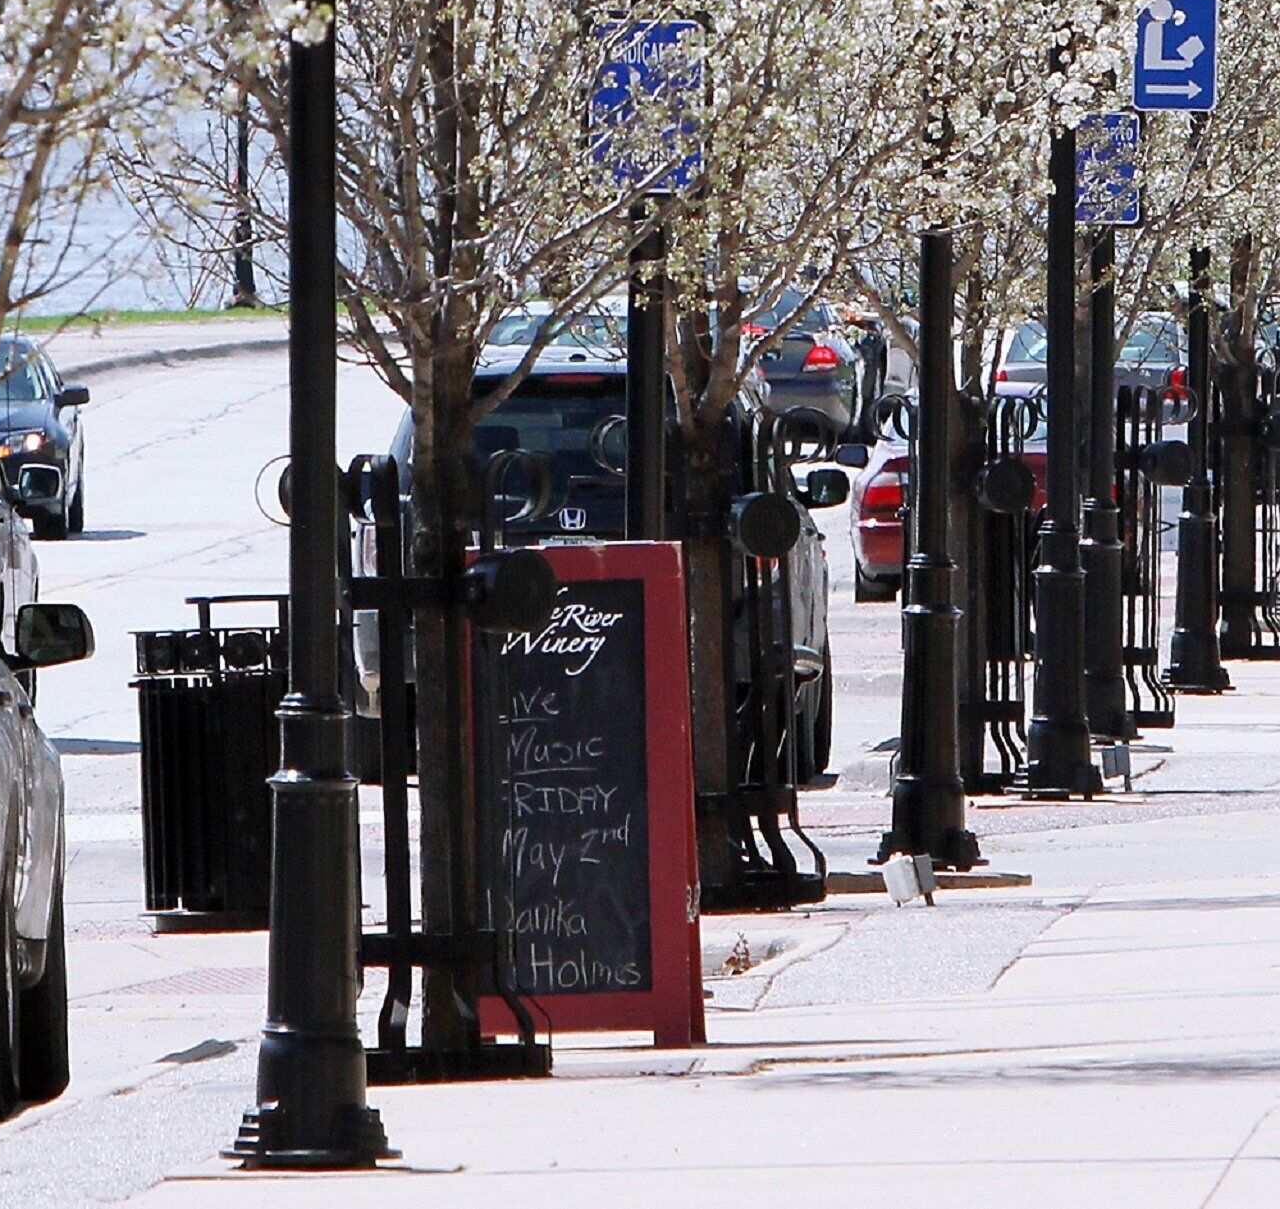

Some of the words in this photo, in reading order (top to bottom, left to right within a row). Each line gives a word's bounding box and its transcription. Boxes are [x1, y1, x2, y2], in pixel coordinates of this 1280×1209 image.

[561, 604, 623, 633] River
[500, 622, 606, 675] Winery
[502, 780, 618, 817] RIDAY
